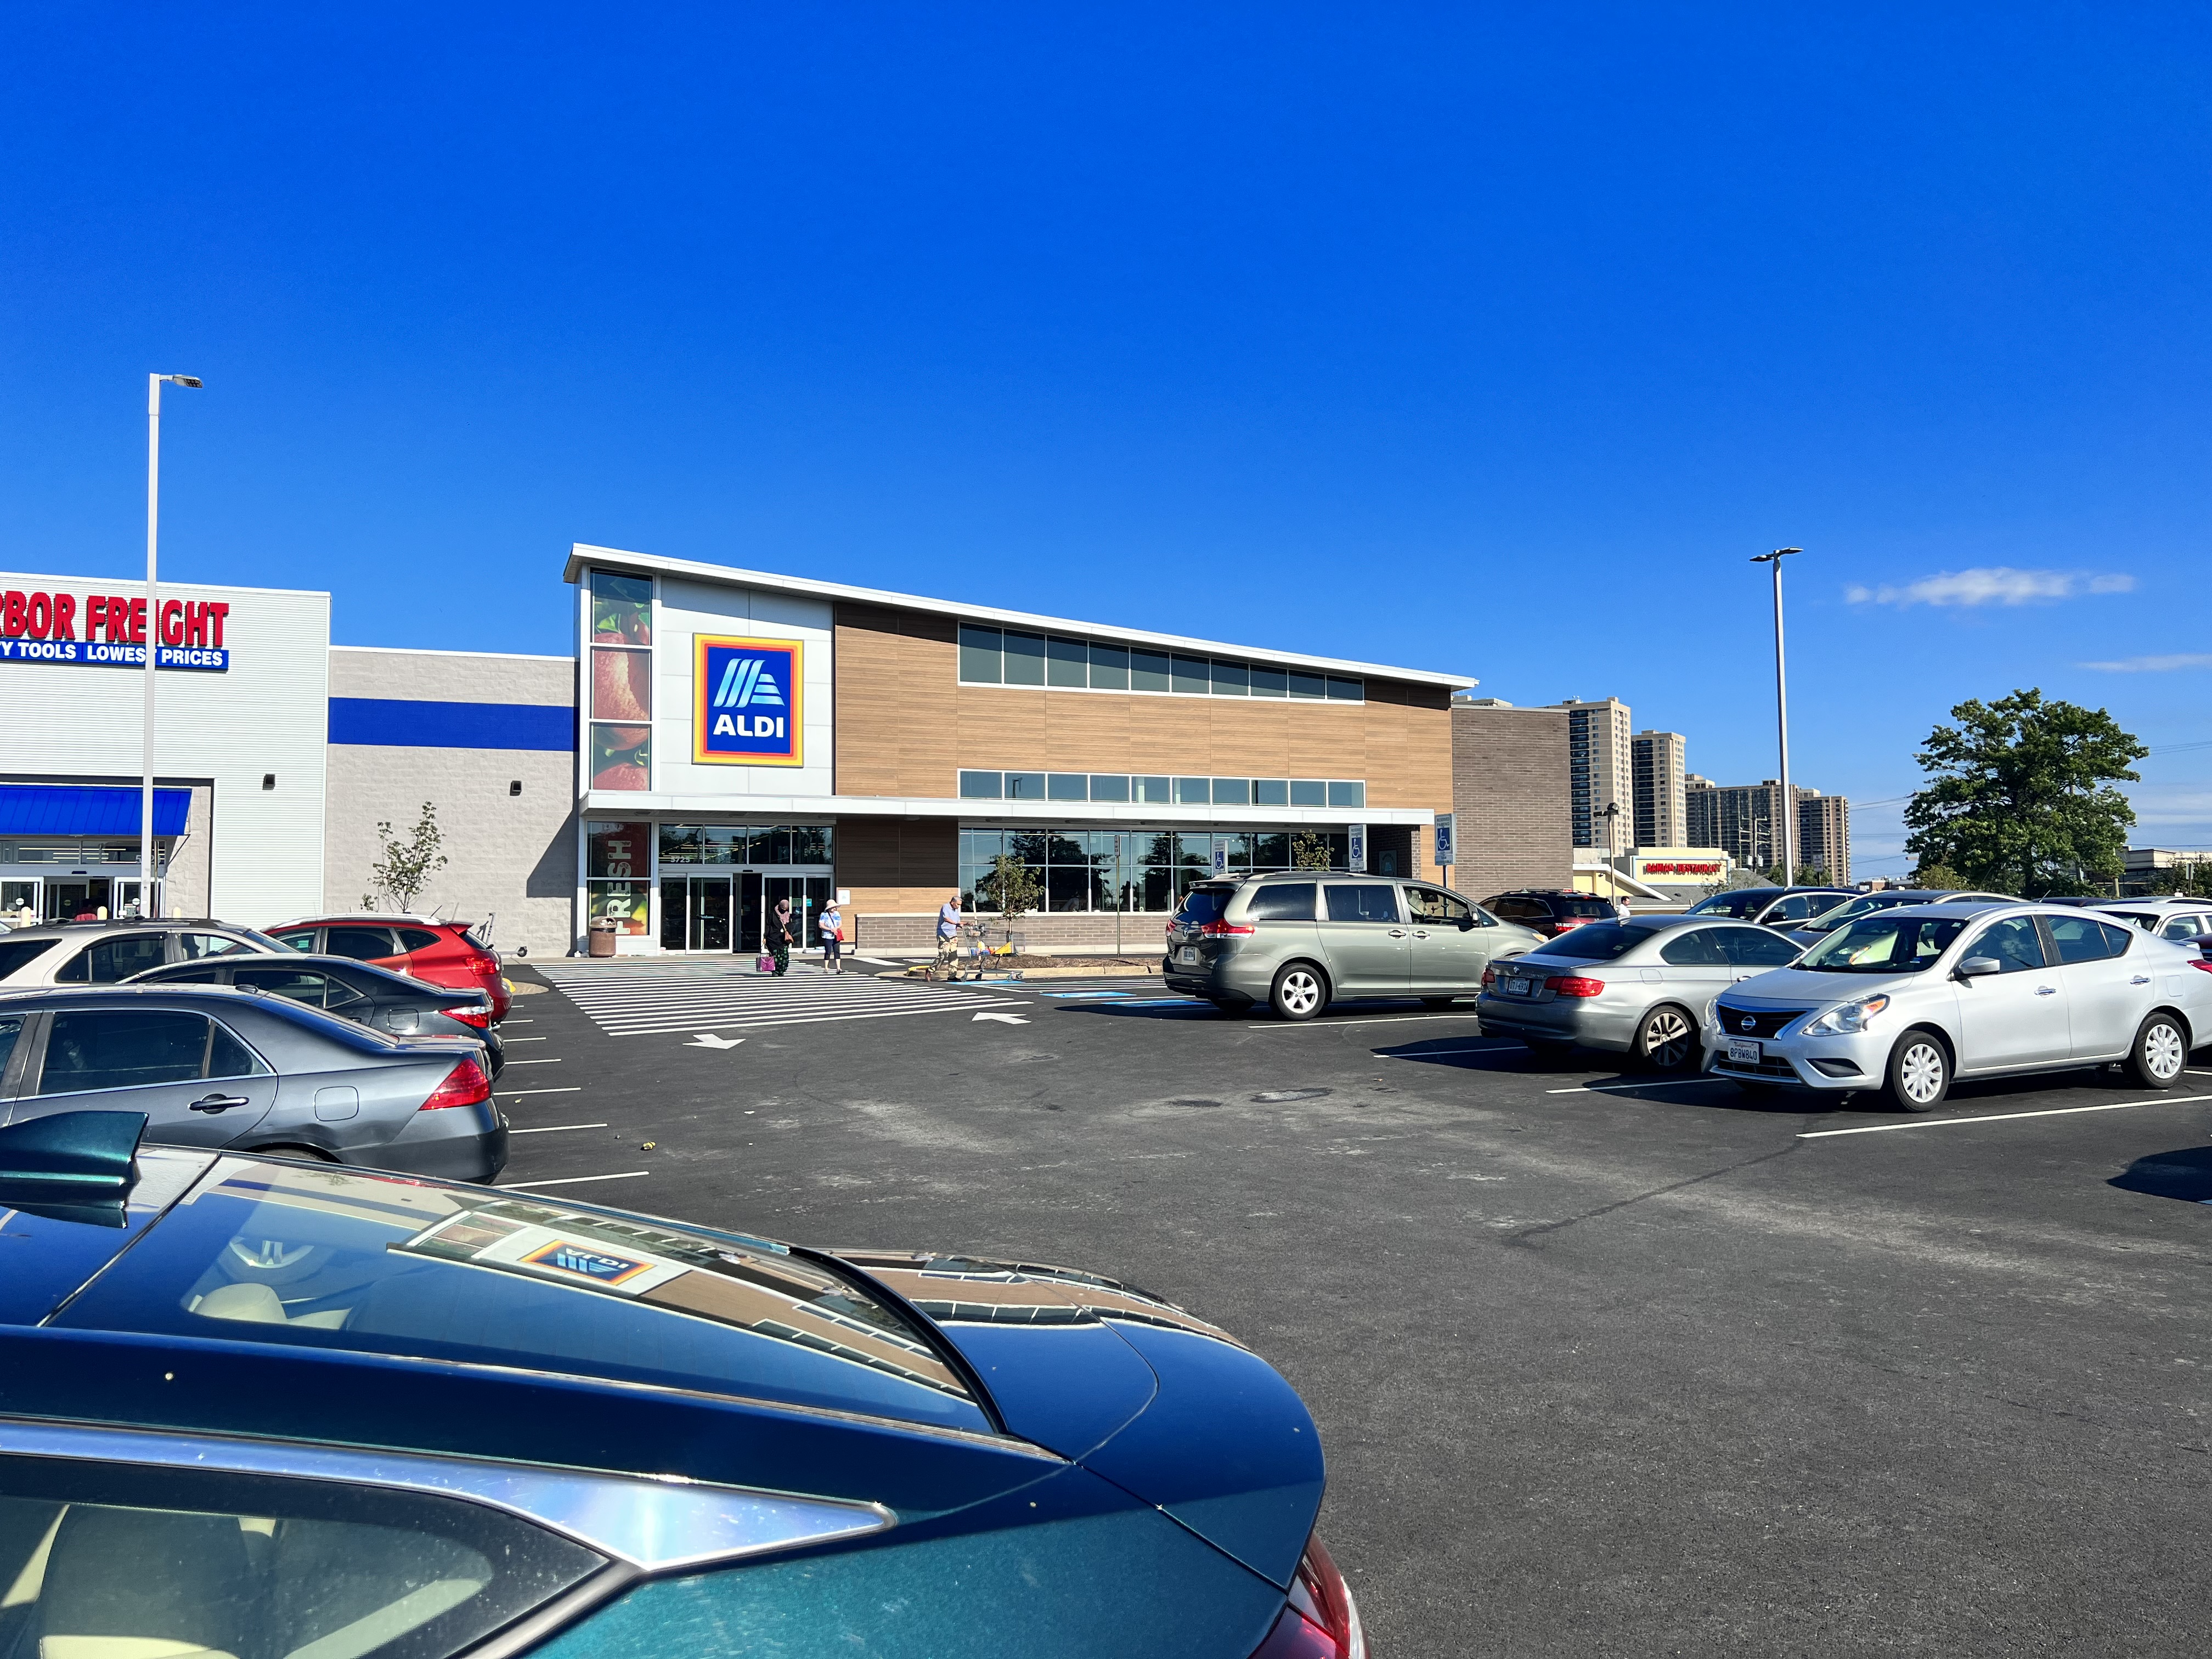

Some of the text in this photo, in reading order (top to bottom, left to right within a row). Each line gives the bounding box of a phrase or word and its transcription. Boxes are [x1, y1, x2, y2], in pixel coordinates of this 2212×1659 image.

[0, 591, 76, 639] BOR
[18, 642, 76, 659] TOOLS
[87, 645, 157, 663] LOWES
[162, 649, 223, 666] PRICES
[713, 714, 783, 738] ALDI
[607, 840, 631, 934] FRESH
[1730, 1047, 1757, 1060] 8PBW840
